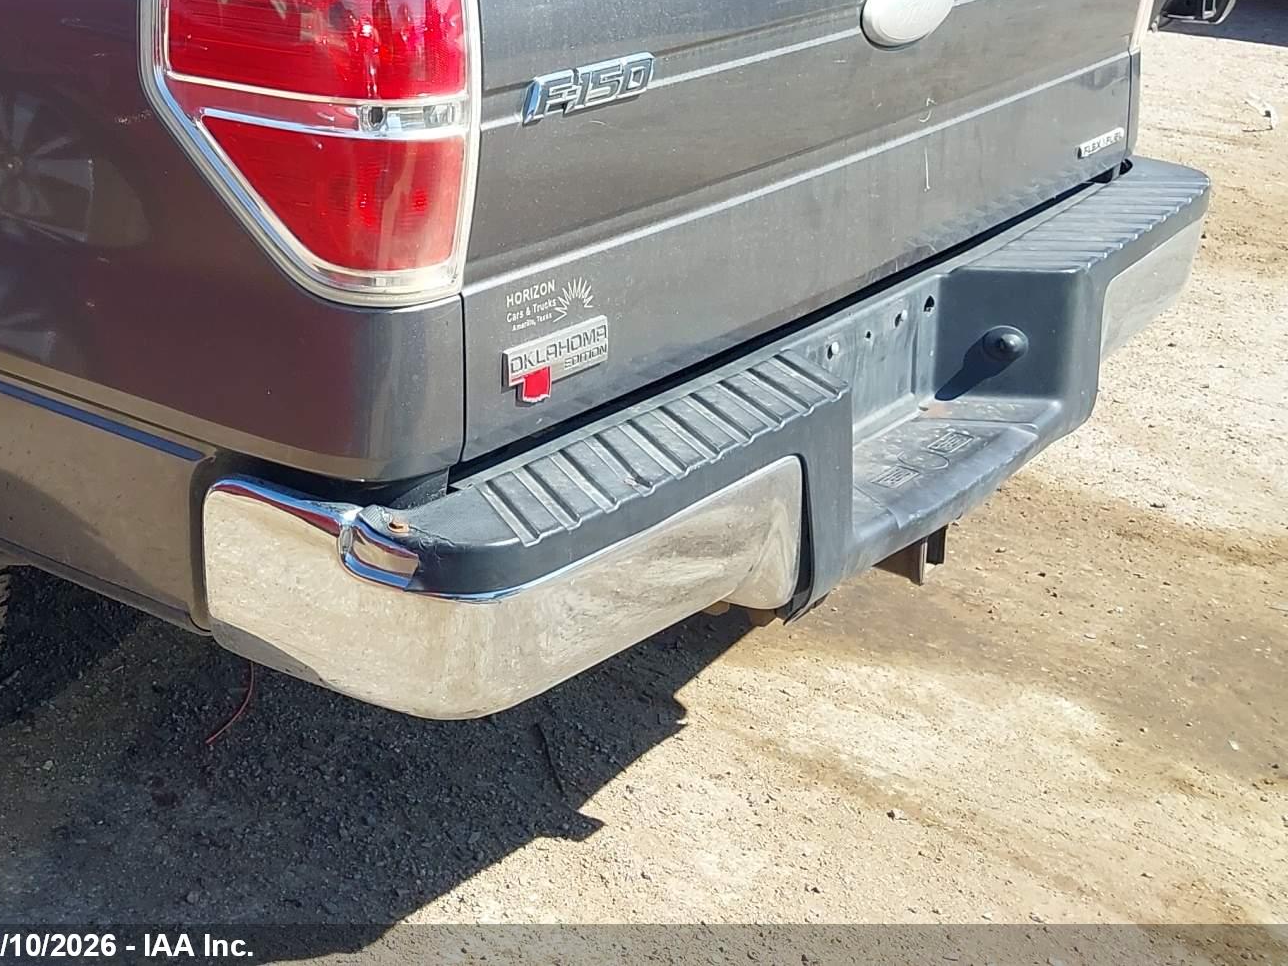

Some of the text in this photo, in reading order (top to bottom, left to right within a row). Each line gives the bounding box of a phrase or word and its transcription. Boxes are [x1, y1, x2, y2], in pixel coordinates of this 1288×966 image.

[506, 279, 556, 309] HORIZON
[506, 309, 524, 323] Cars
[532, 298, 557, 313] Trucks
[510, 324, 607, 374] OKLAHOMA
[564, 343, 608, 369] EDITION
